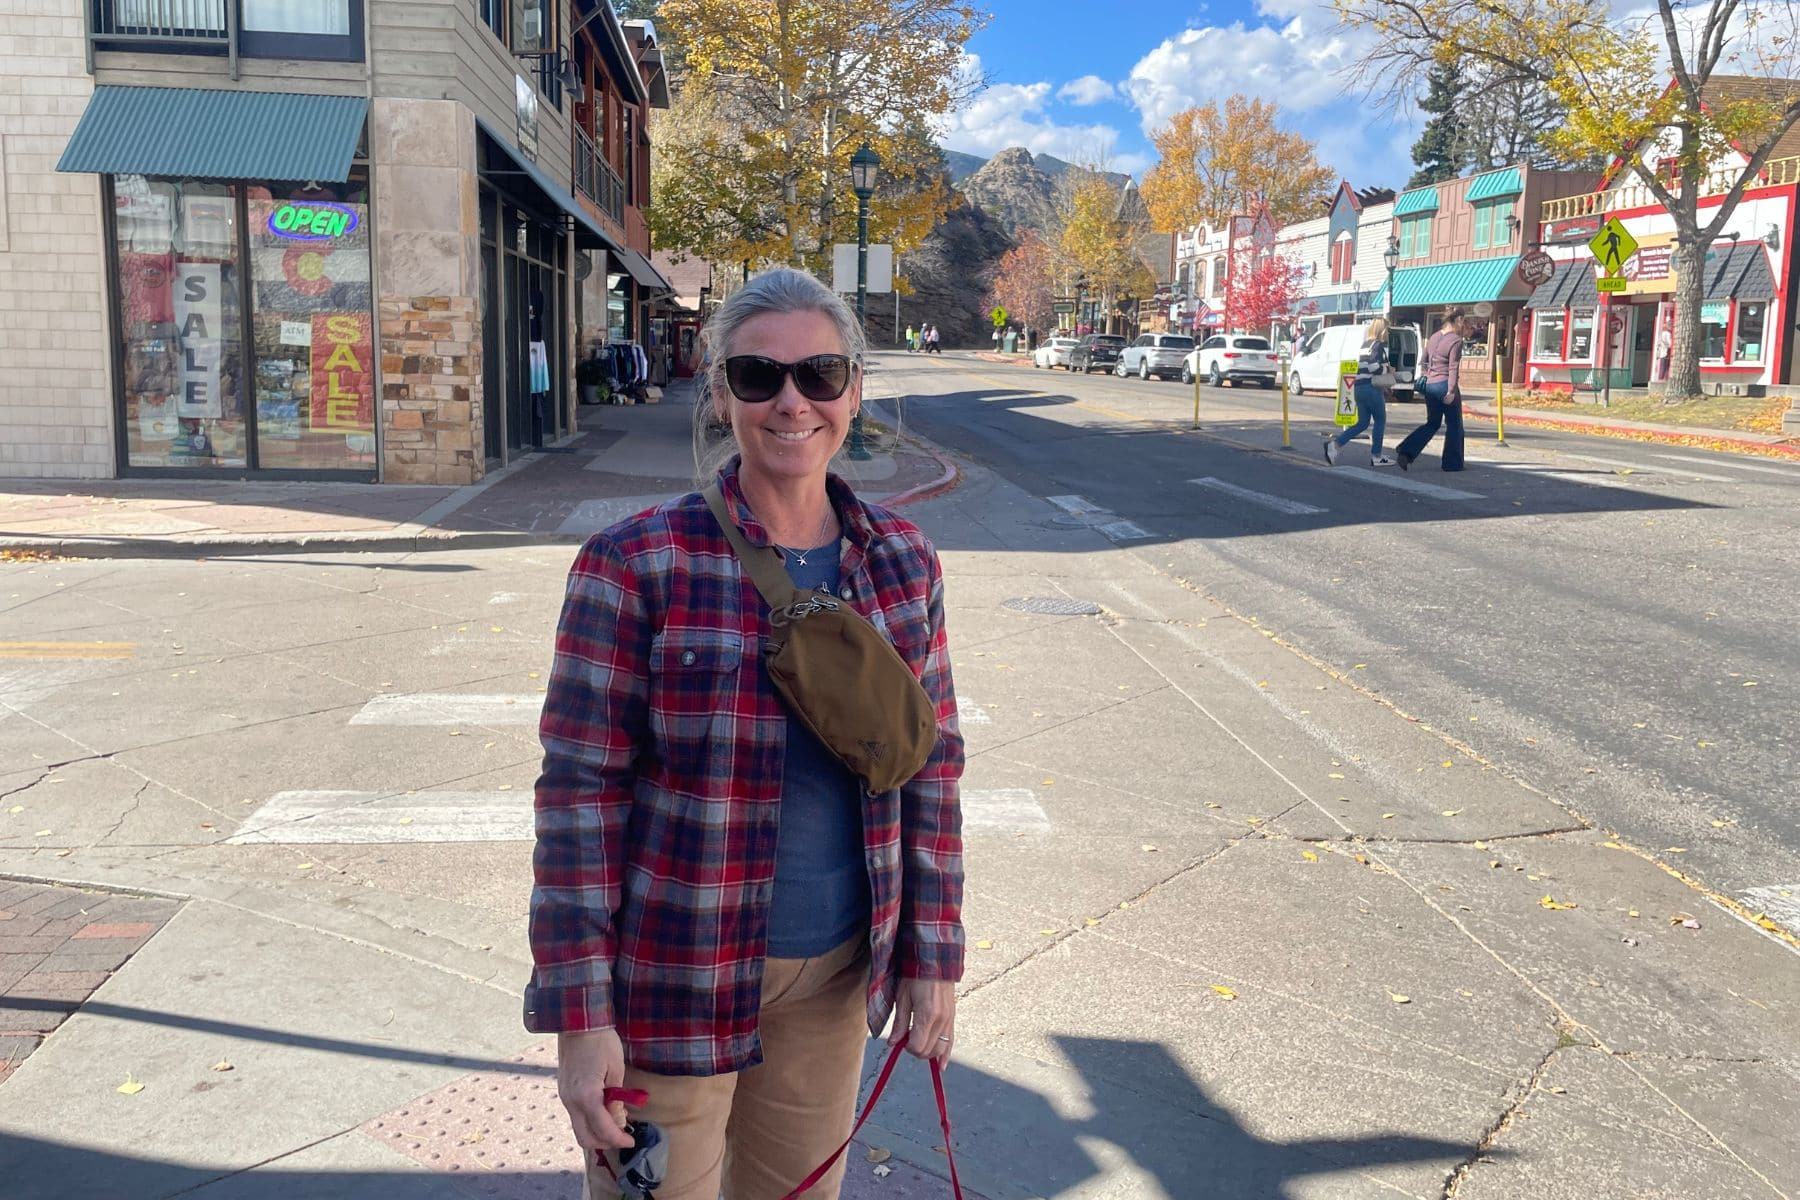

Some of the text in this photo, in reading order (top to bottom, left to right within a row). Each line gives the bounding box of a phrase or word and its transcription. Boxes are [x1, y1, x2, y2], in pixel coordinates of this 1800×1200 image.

[274, 206, 350, 237] OPEN
[182, 275, 209, 404] SALE
[284, 327, 305, 336] ATM
[324, 316, 361, 426] SALE
